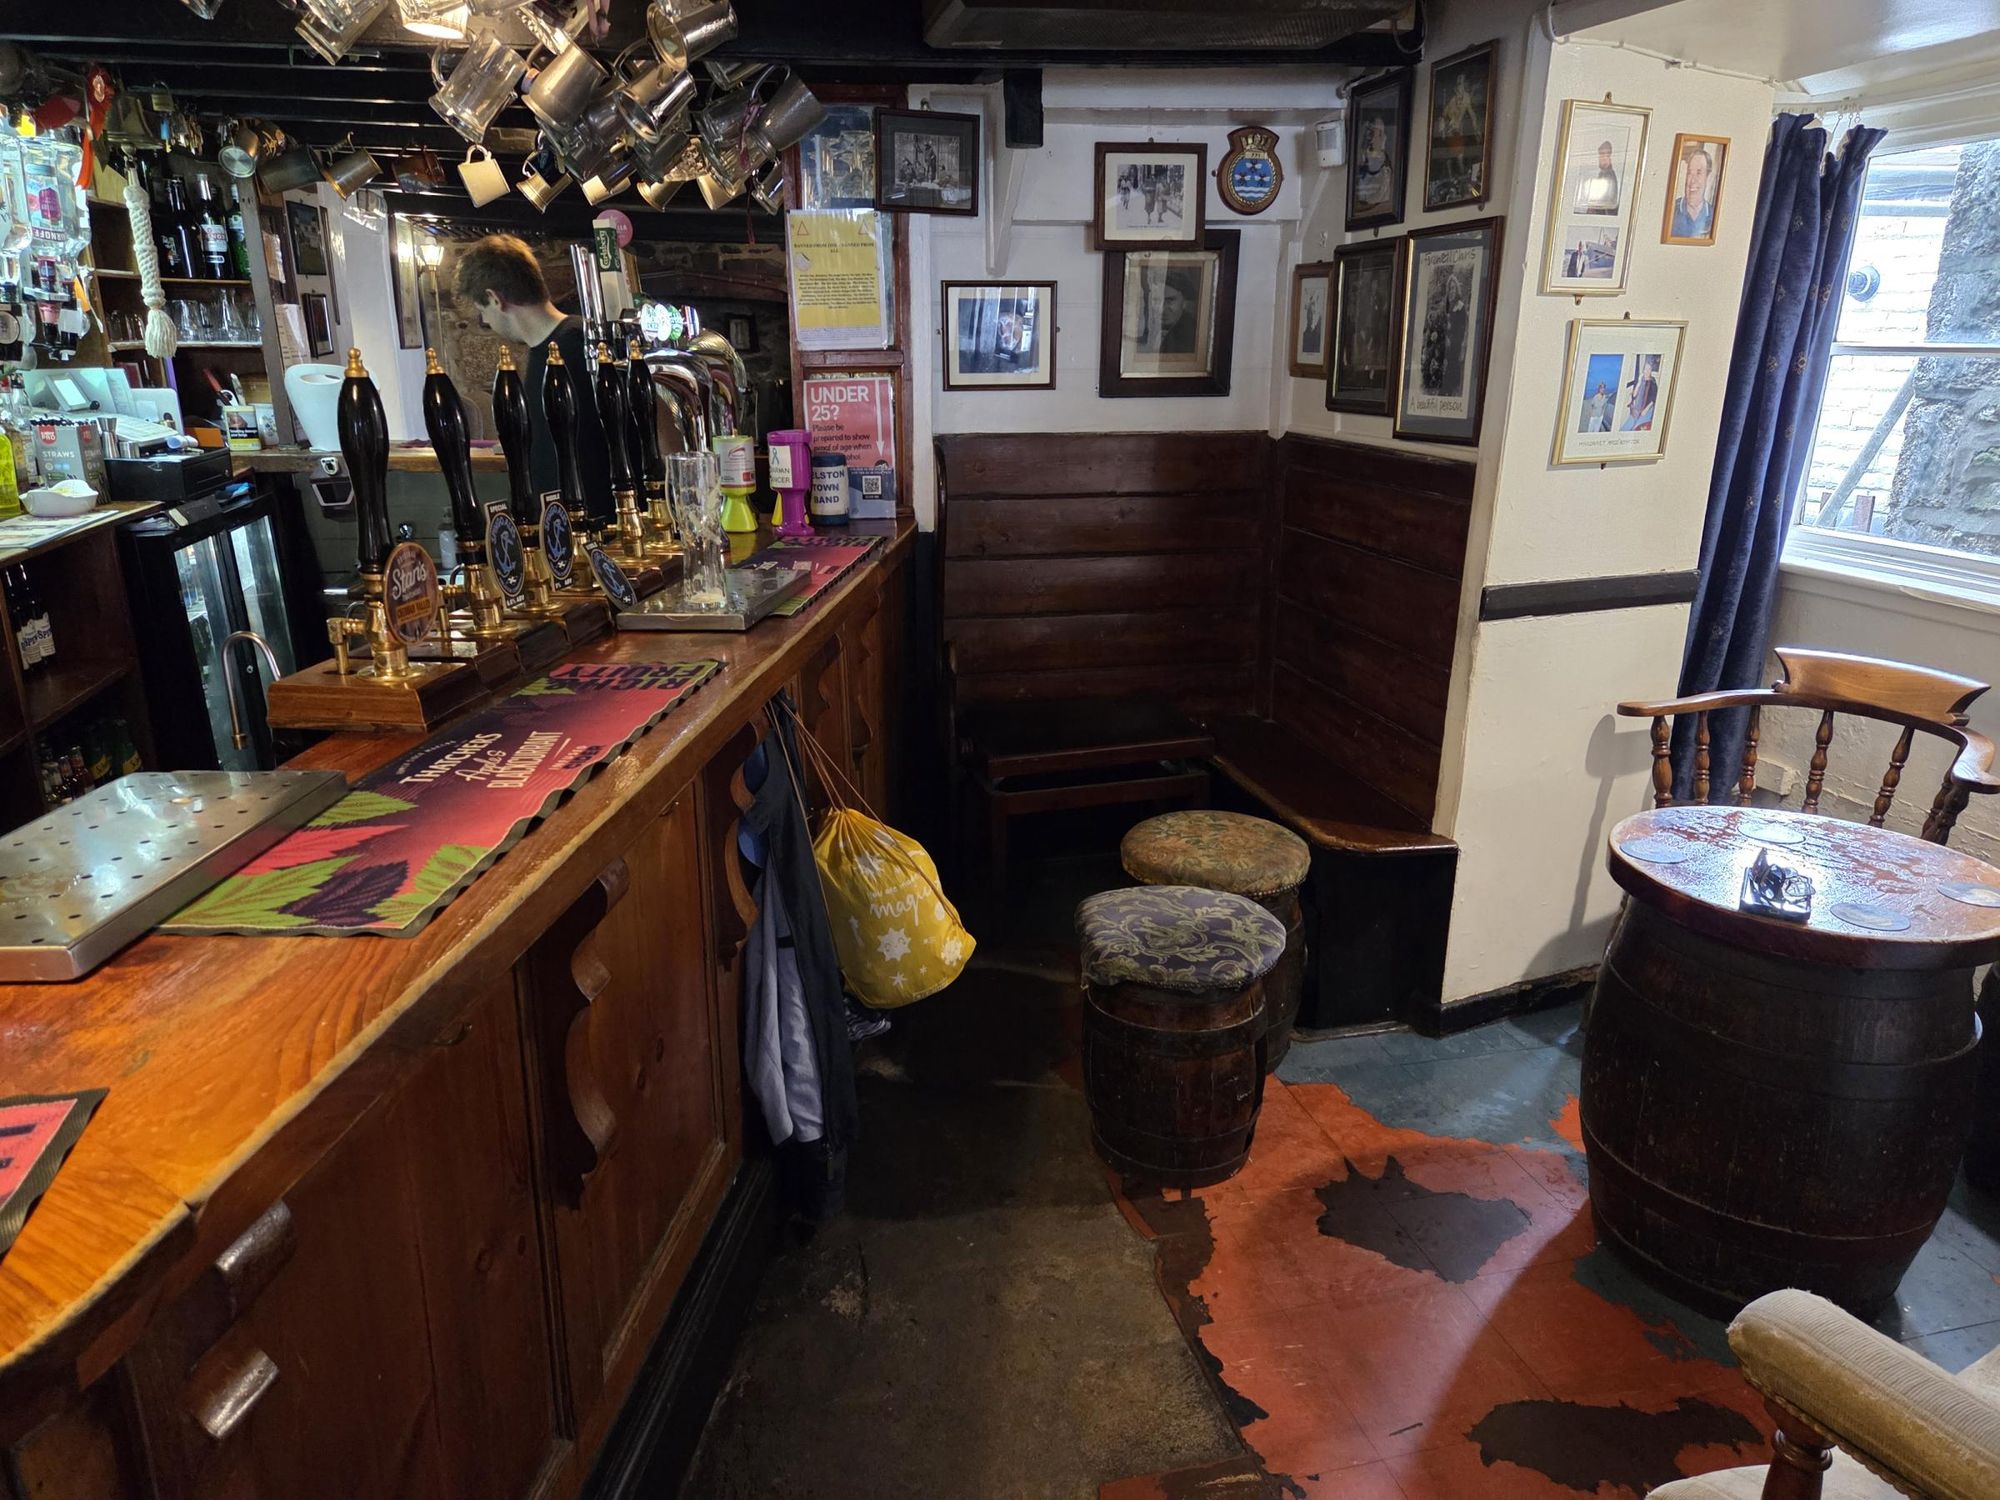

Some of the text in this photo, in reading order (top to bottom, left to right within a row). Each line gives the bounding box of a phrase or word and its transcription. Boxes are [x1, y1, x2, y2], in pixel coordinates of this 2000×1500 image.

[810, 386, 870, 403] UNDER
[812, 405, 840, 421] 25?
[813, 434, 844, 443] prepared
[840, 444, 854, 452] age
[854, 442, 872, 450] when
[812, 484, 840, 492] TOWN
[814, 495, 840, 504] BAND
[556, 665, 705, 678] FRUITY
[578, 677, 690, 690] RICH
[398, 732, 502, 784] THATCHERS
[486, 730, 564, 788] BLACKCURRANT
